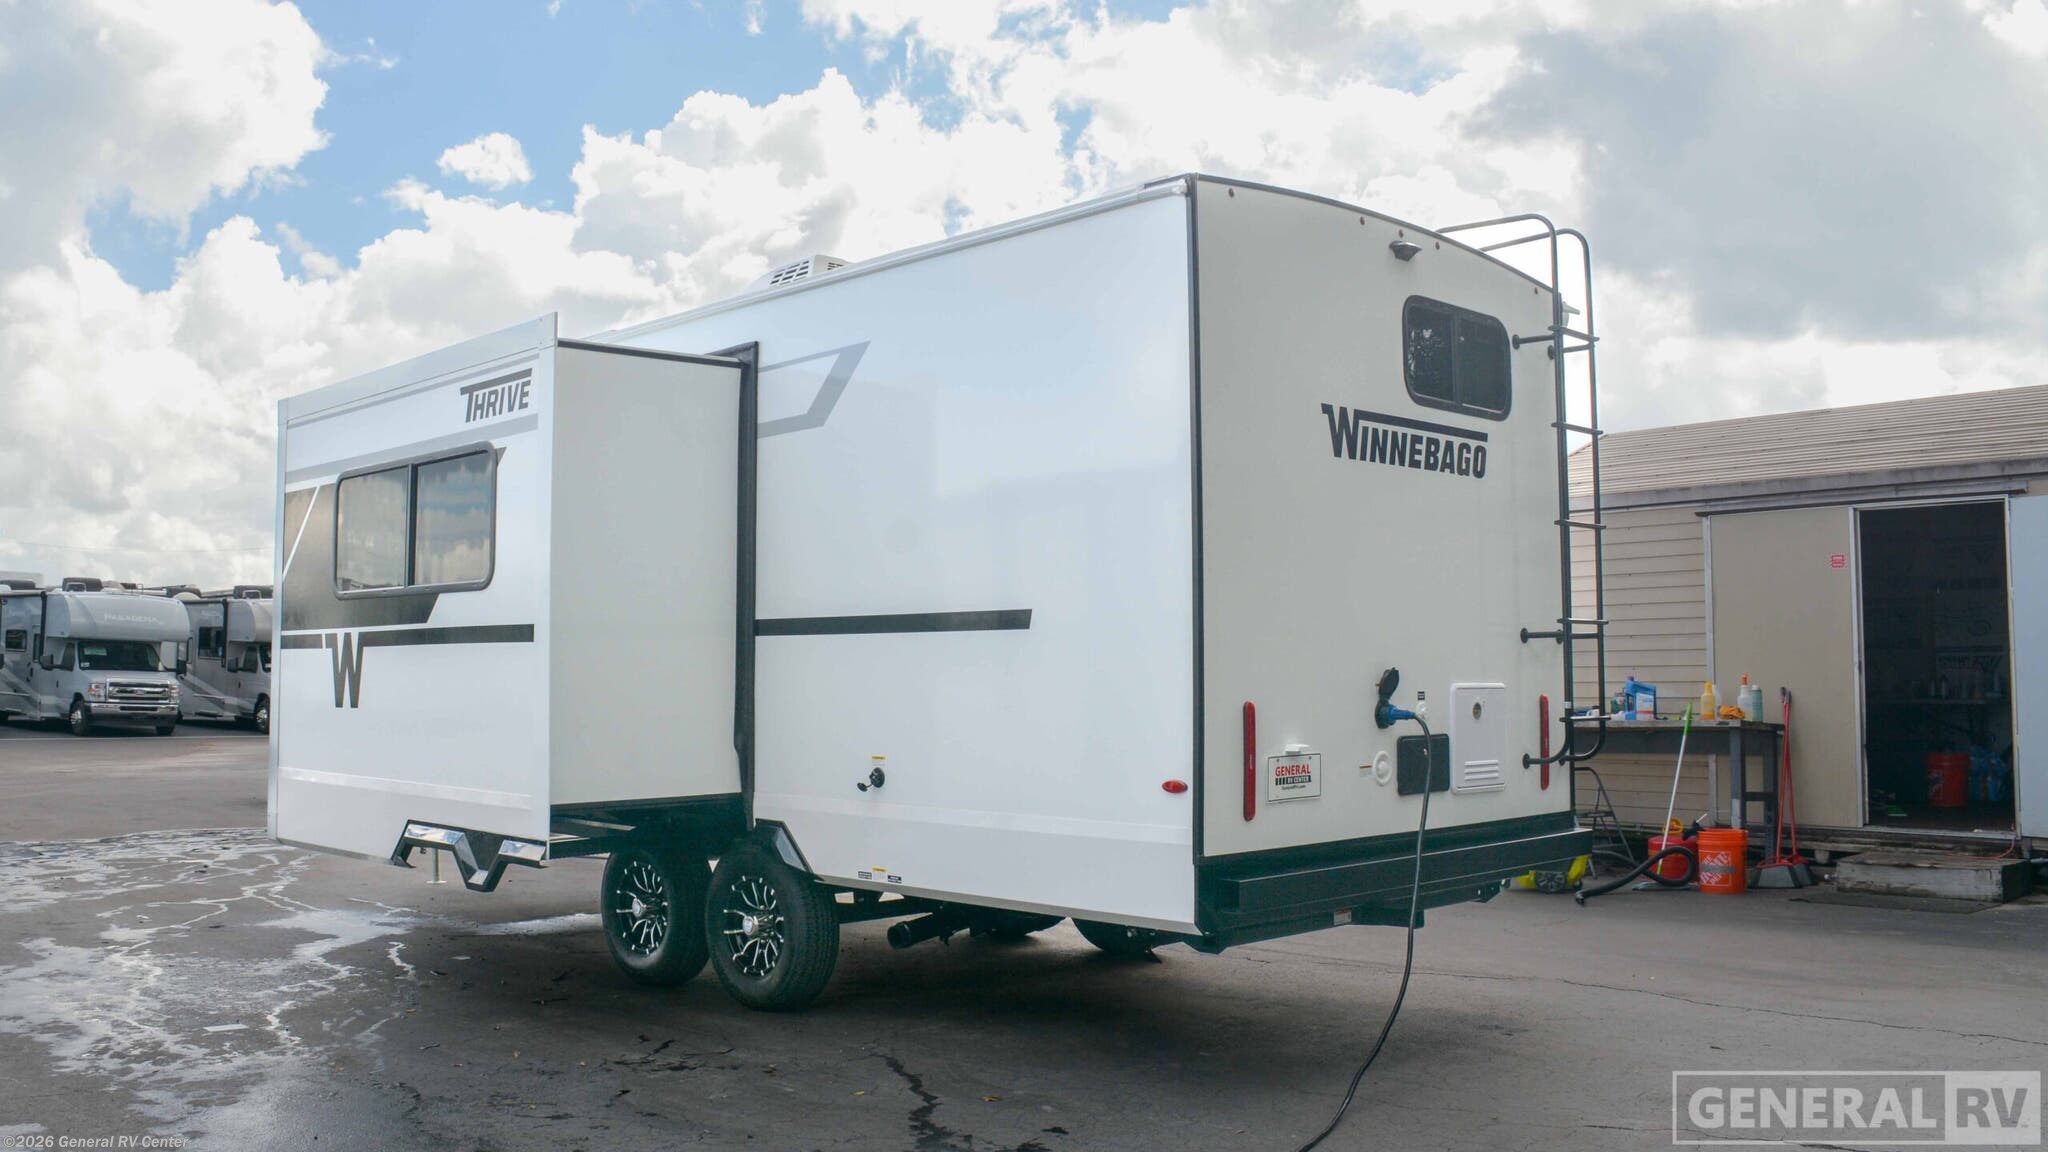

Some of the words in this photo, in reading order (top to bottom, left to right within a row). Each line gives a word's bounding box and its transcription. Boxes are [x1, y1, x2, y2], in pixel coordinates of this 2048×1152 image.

[460, 368, 533, 423] THRIVE
[1321, 402, 1489, 479] WINNEBAGO
[1275, 764, 1312, 777] GENERAL
